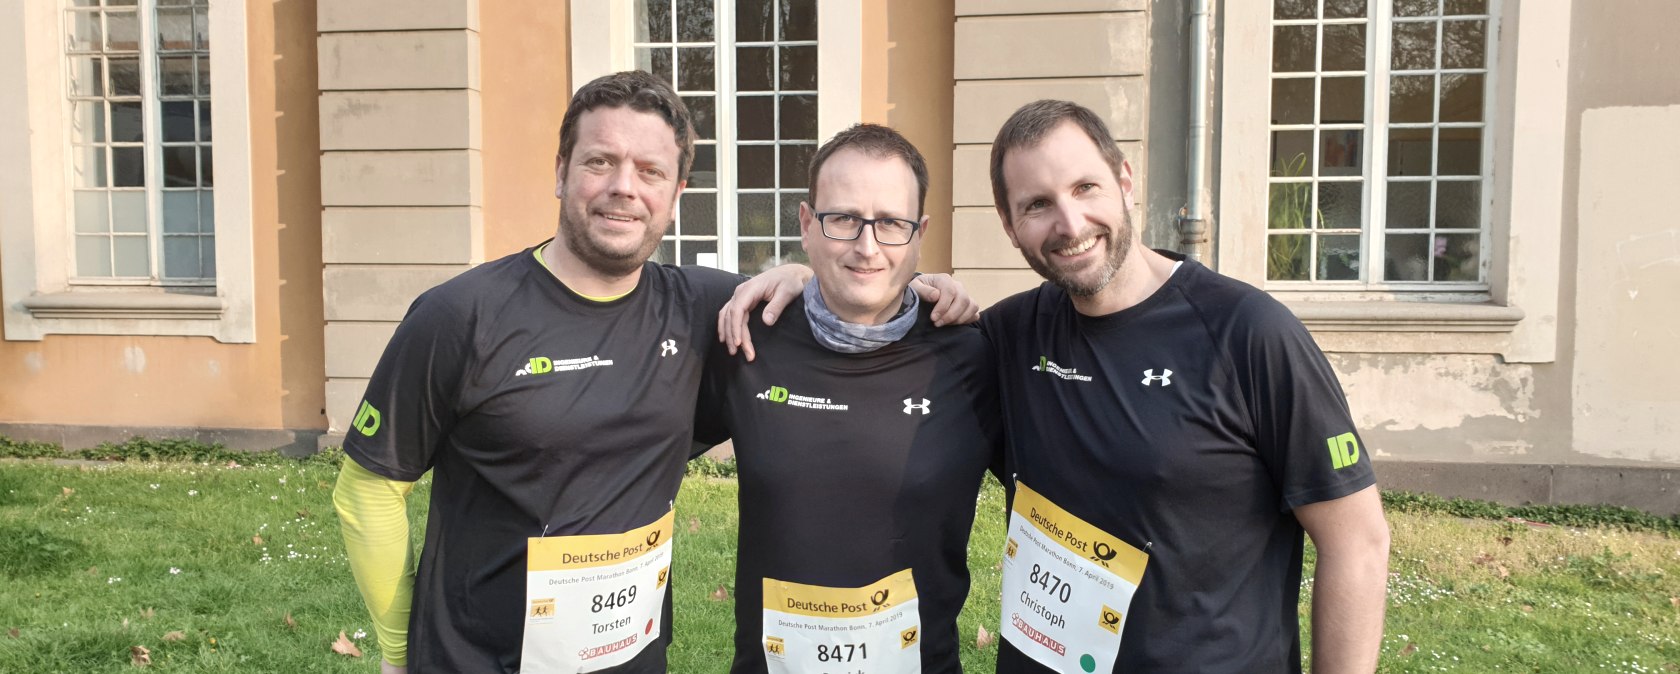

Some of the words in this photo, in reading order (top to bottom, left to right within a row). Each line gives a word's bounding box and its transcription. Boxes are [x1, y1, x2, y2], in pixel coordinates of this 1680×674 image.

[769, 385, 788, 403] ID
[787, 399, 849, 411] DIENSTLEISTUNGEN
[788, 393, 826, 404] INGENIEURE
[352, 399, 381, 437] ID
[1326, 431, 1360, 470] ID
[1030, 507, 1064, 539] Deutsche
[1065, 531, 1089, 553] Post
[562, 549, 620, 565] Deutsche
[622, 543, 643, 558] Post
[548, 576, 580, 586] Deutsche
[597, 570, 625, 581] Marathon
[1041, 543, 1063, 562] Marathon
[1084, 570, 1099, 582] April
[1099, 577, 1115, 590] 2019
[1029, 563, 1072, 604] 8470
[590, 585, 637, 614] 8469
[787, 597, 839, 613] Deutsche
[841, 601, 867, 613] Post
[1019, 590, 1066, 629] Christoph
[592, 616, 631, 635] Torsten
[778, 619, 803, 629] Deutsche
[818, 624, 848, 632] Marathon
[875, 617, 889, 627] April
[889, 611, 903, 623] 2019
[589, 633, 638, 657] BAUHAUS
[1018, 618, 1066, 656] BAUHAUS
[817, 642, 867, 663] 8471
